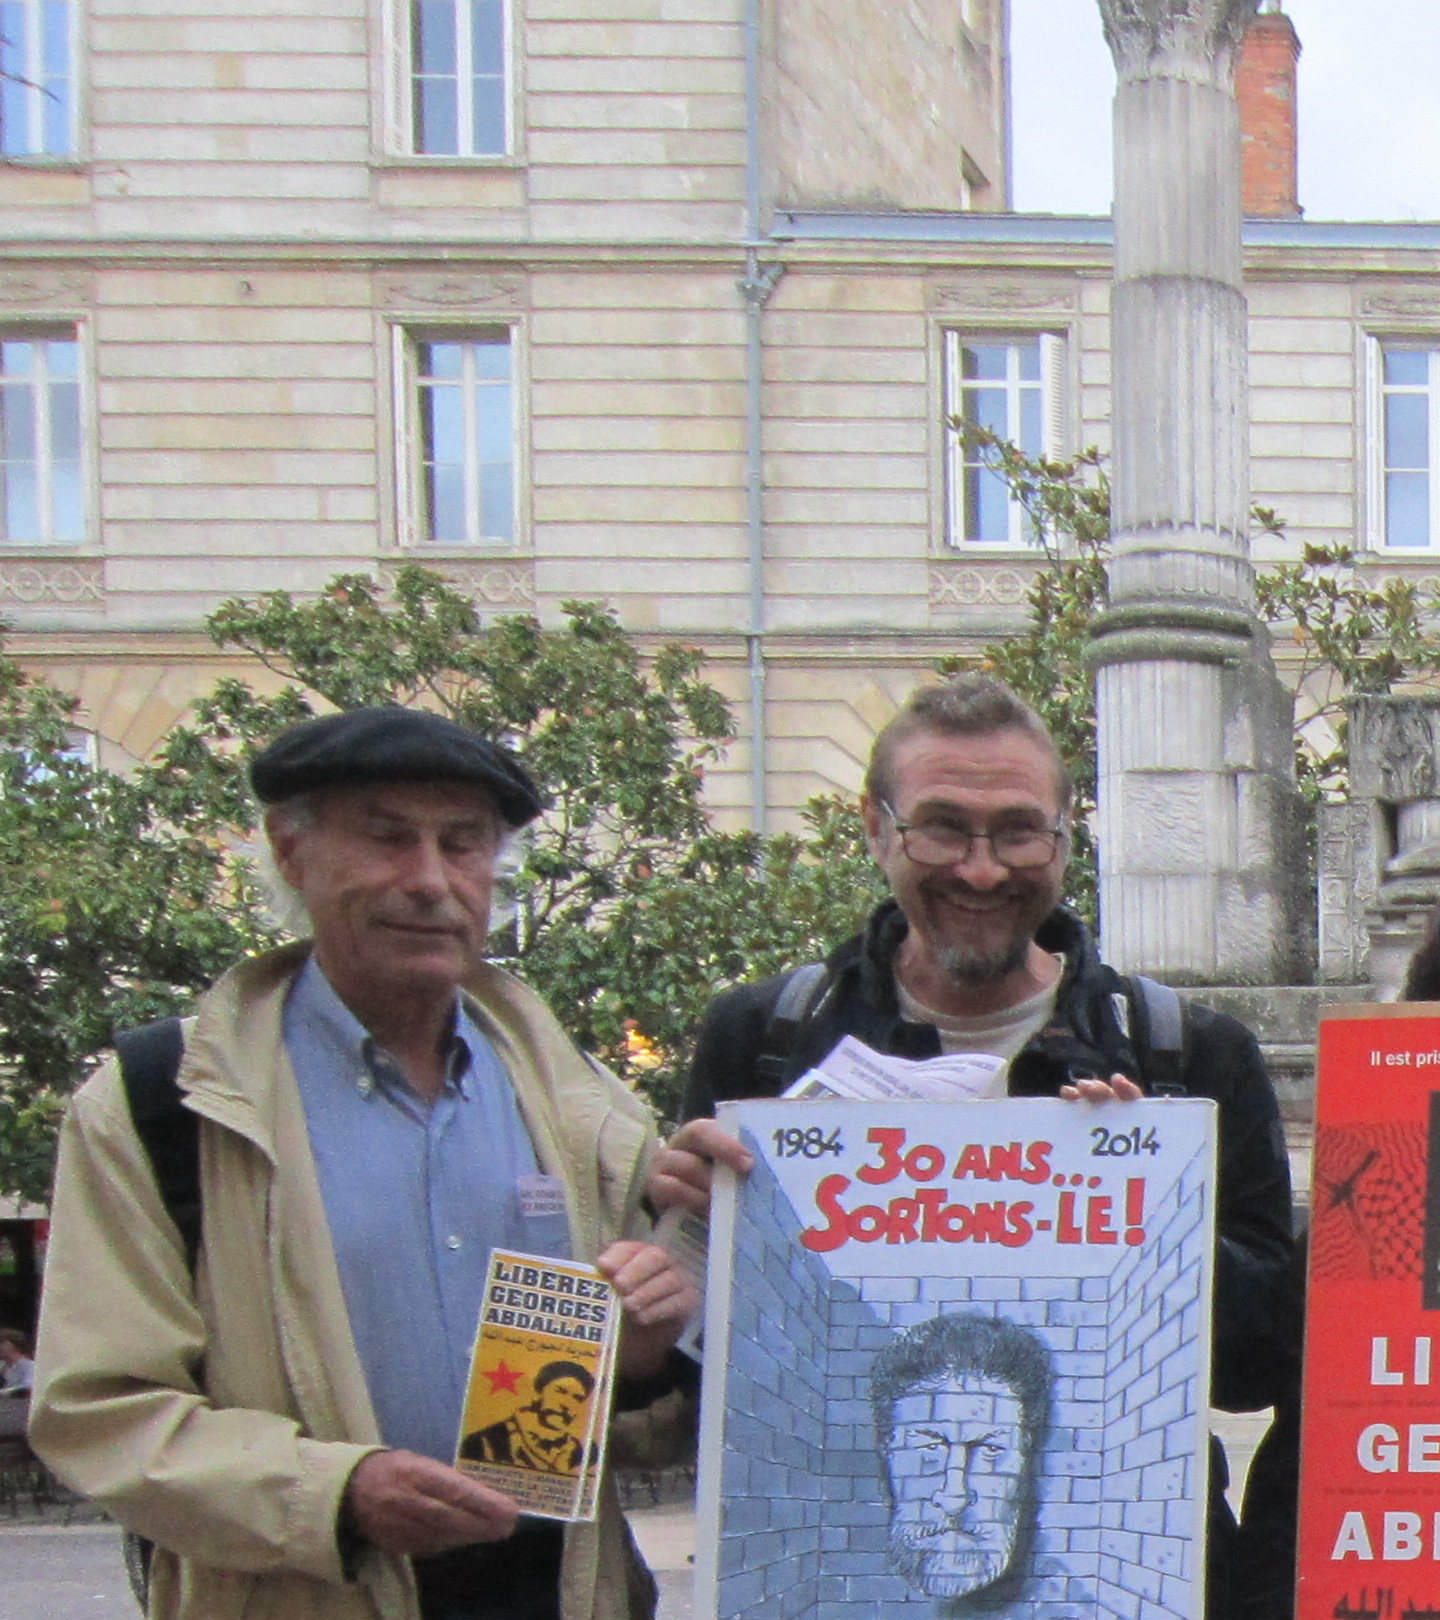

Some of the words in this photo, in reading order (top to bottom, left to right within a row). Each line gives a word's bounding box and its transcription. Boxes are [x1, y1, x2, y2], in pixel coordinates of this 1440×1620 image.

[1370, 1051, 1381, 1066] Il
[1385, 1051, 1412, 1066] est
[773, 1125, 844, 1158] 1984
[1091, 1125, 1161, 1157] 2014
[857, 1127, 945, 1186] 30
[955, 1138, 1101, 1191] ANS...
[489, 1285, 608, 1323] GEORGES
[485, 1307, 602, 1341] ABDALLAH
